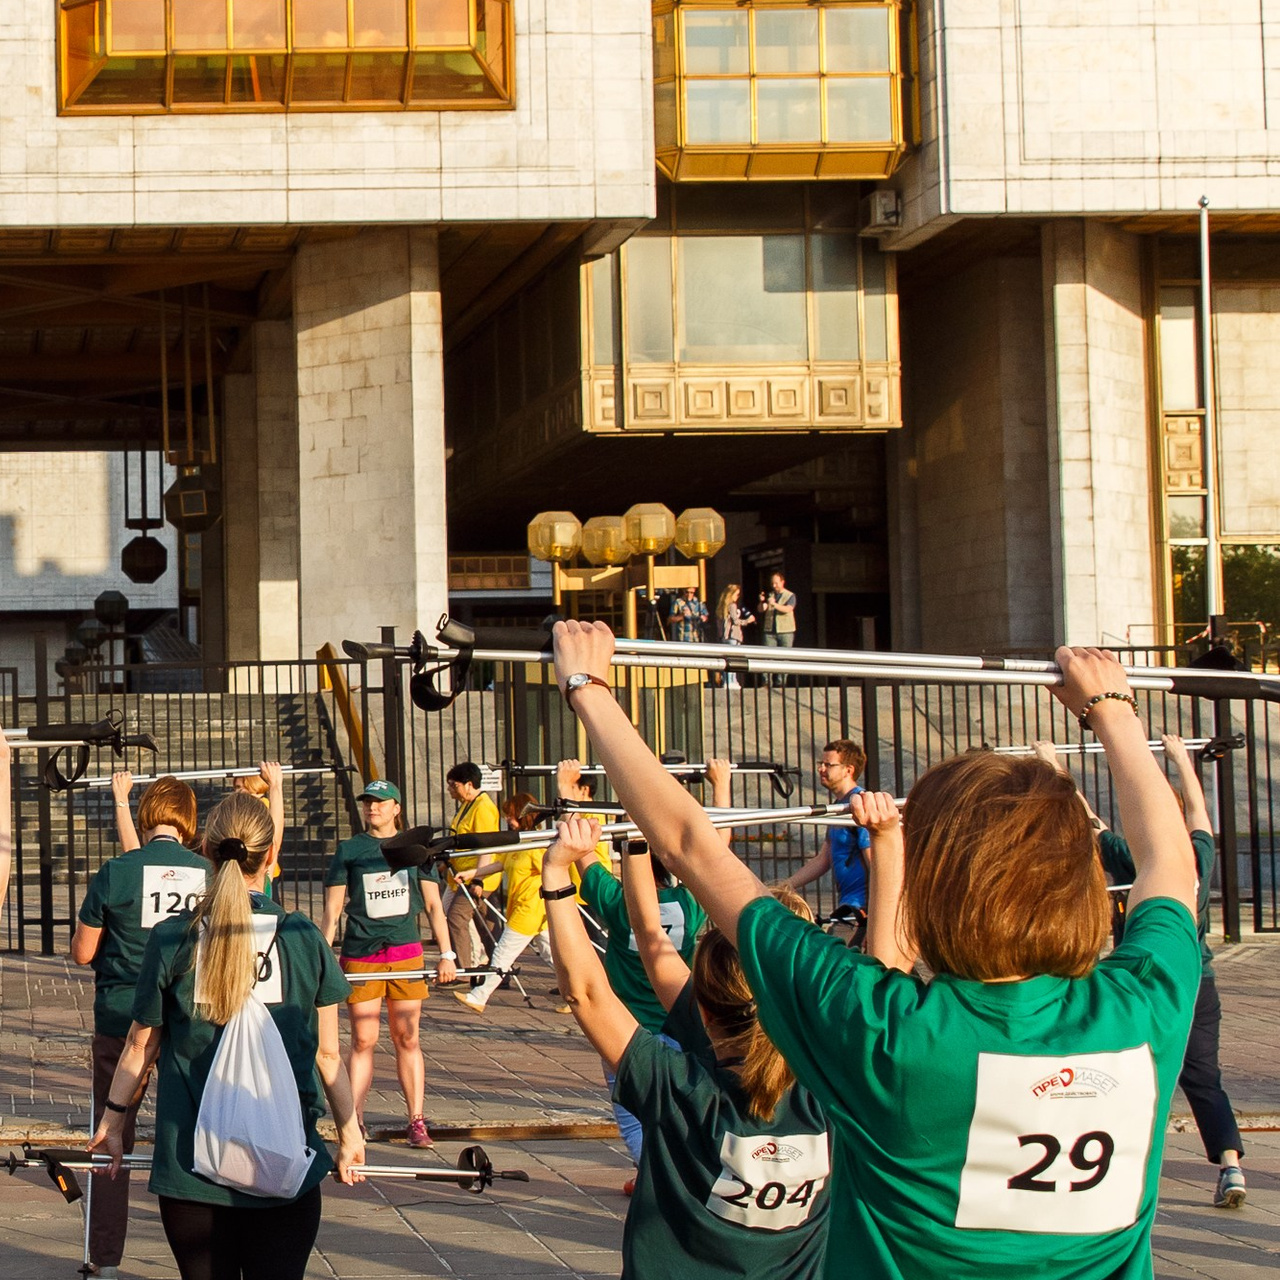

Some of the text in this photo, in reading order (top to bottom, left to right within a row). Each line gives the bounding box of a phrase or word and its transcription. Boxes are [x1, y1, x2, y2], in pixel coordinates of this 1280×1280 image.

[367, 887, 407, 900] ТРЕНЕР
[1007, 1130, 1115, 1193] 29
[720, 1174, 817, 1209] 204
